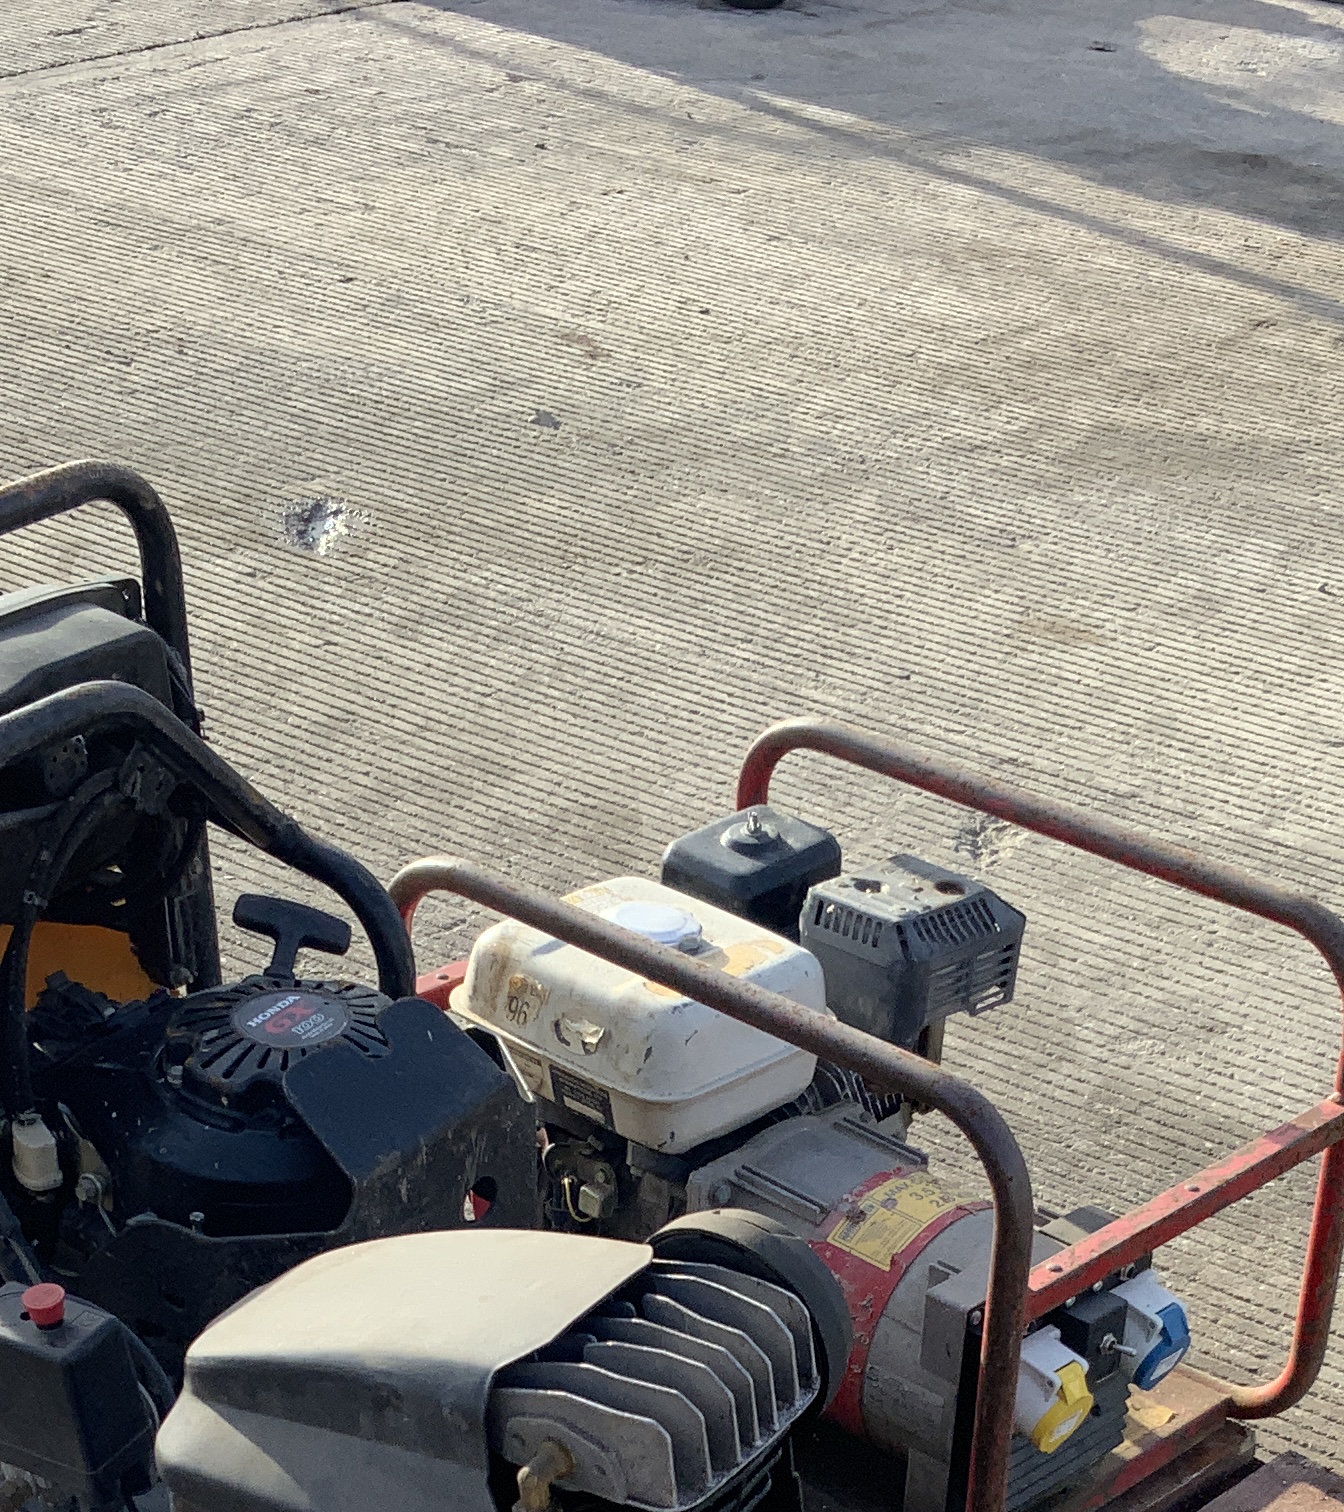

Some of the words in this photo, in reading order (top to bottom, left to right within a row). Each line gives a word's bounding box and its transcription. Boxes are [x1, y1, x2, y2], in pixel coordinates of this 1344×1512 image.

[246, 995, 301, 1027] HONDA
[264, 1005, 317, 1034] GX
[507, 996, 530, 1026] 96
